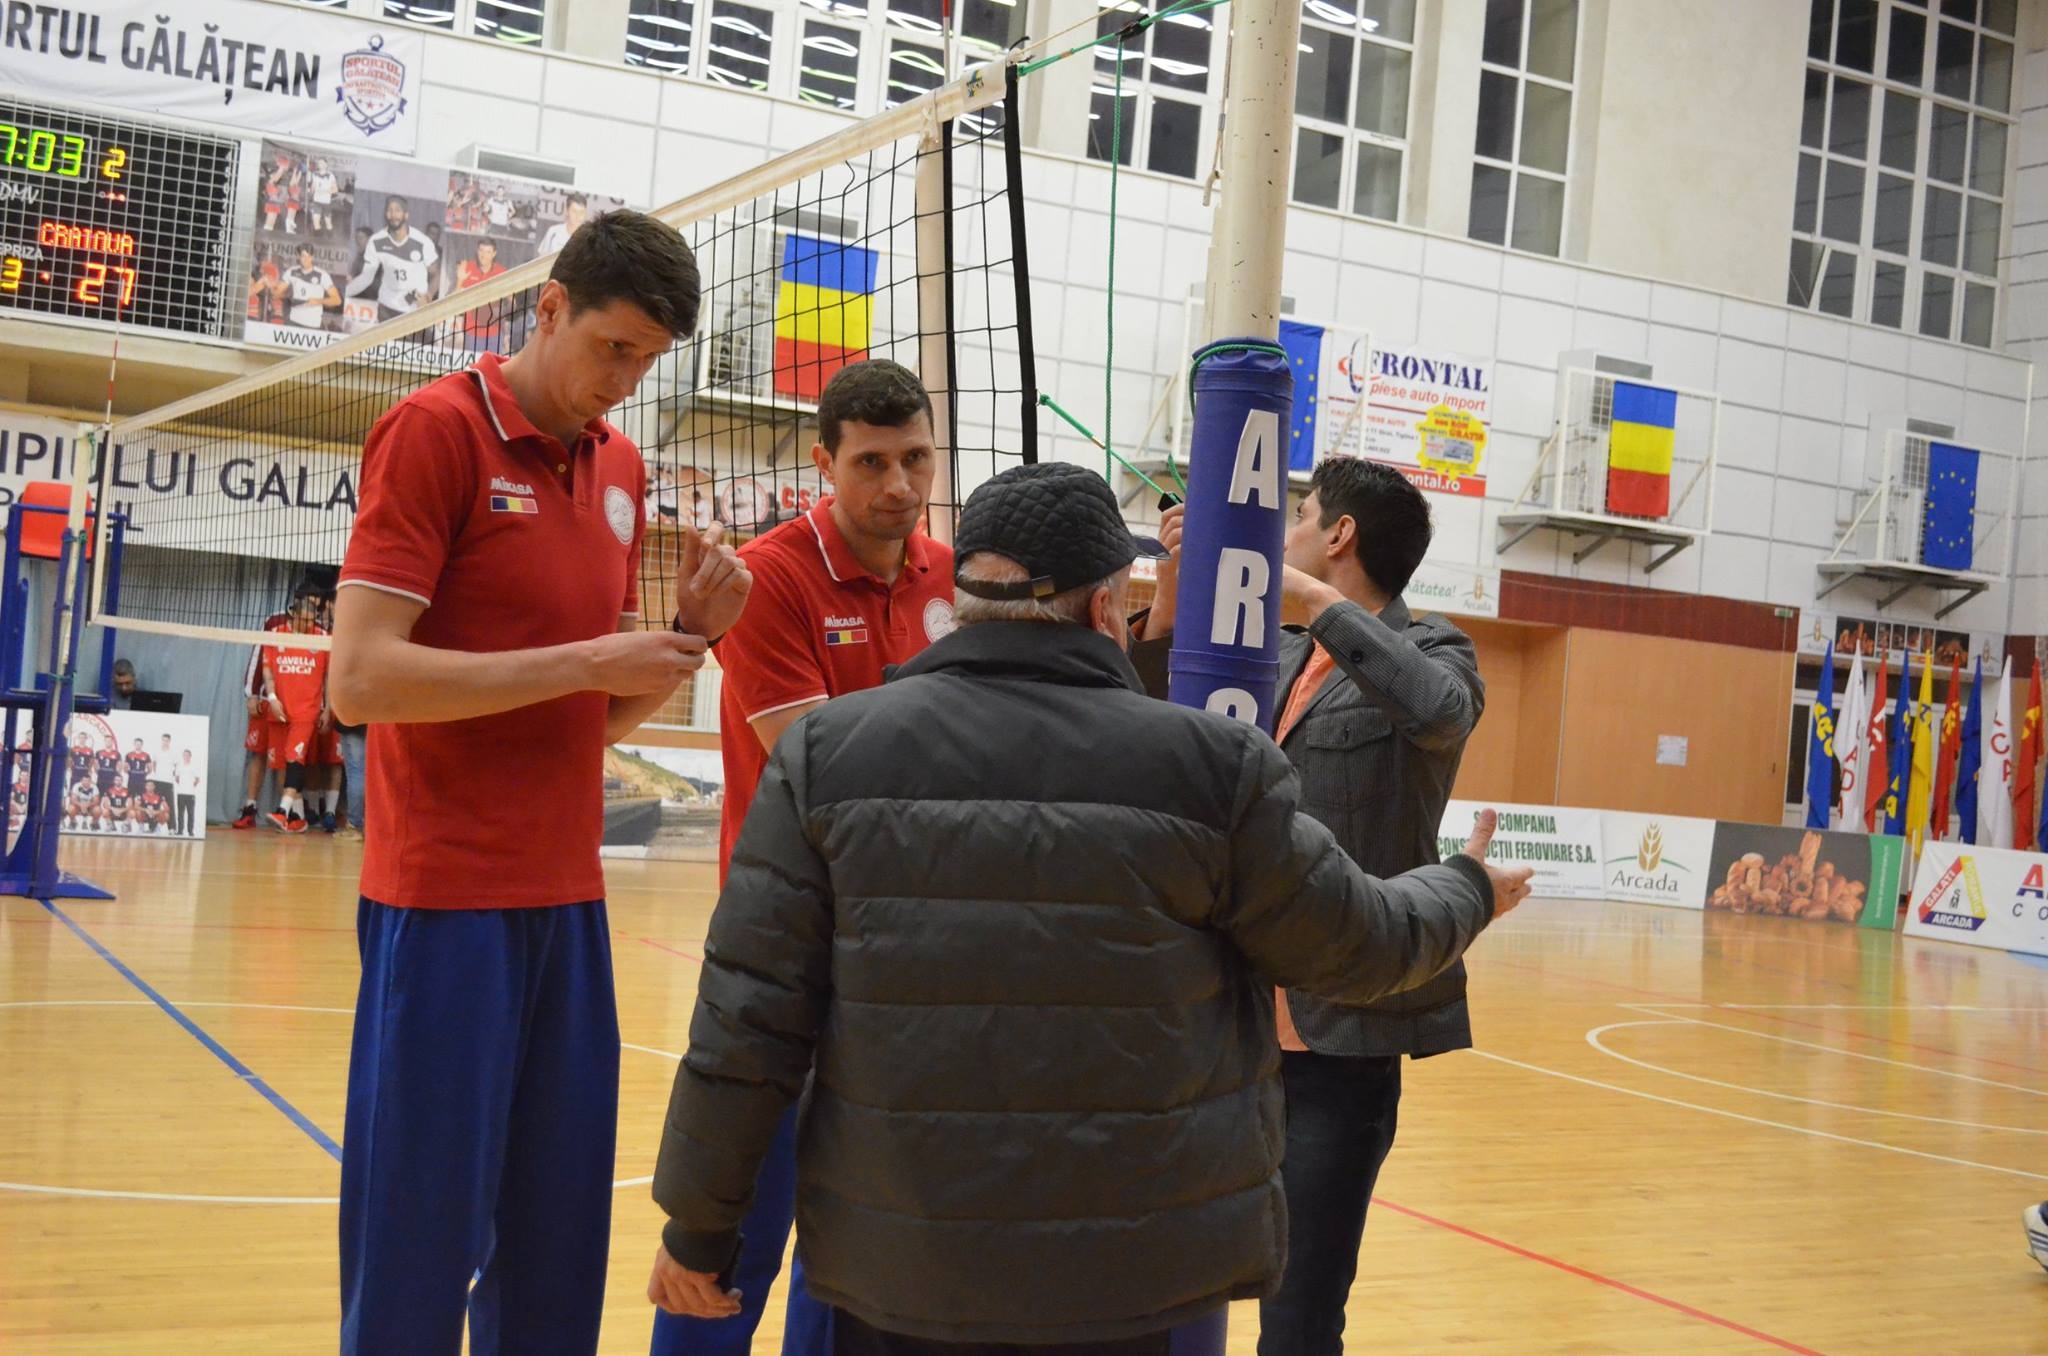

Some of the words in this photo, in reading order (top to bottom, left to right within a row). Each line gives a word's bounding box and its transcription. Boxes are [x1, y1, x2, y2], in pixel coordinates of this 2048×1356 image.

[0, 0, 107, 64] RTUL
[121, 14, 321, 105] GĂLĂȚEAN
[103, 147, 126, 179] 2
[78, 261, 136, 306] 27
[393, 269, 408, 282] 13
[1371, 349, 1489, 393] FRONTAL
[1369, 381, 1408, 397] piese
[1409, 389, 1440, 404] auto
[1443, 391, 1487, 412] import
[1498, 813, 1557, 835] COMPANIA
[1515, 841, 1574, 863] FEROVIARE
[1576, 847, 1597, 864] S.A.
[1611, 869, 1679, 892] Arcada
[2016, 863, 2048, 899] A
[1931, 913, 1973, 929] ARCADA
